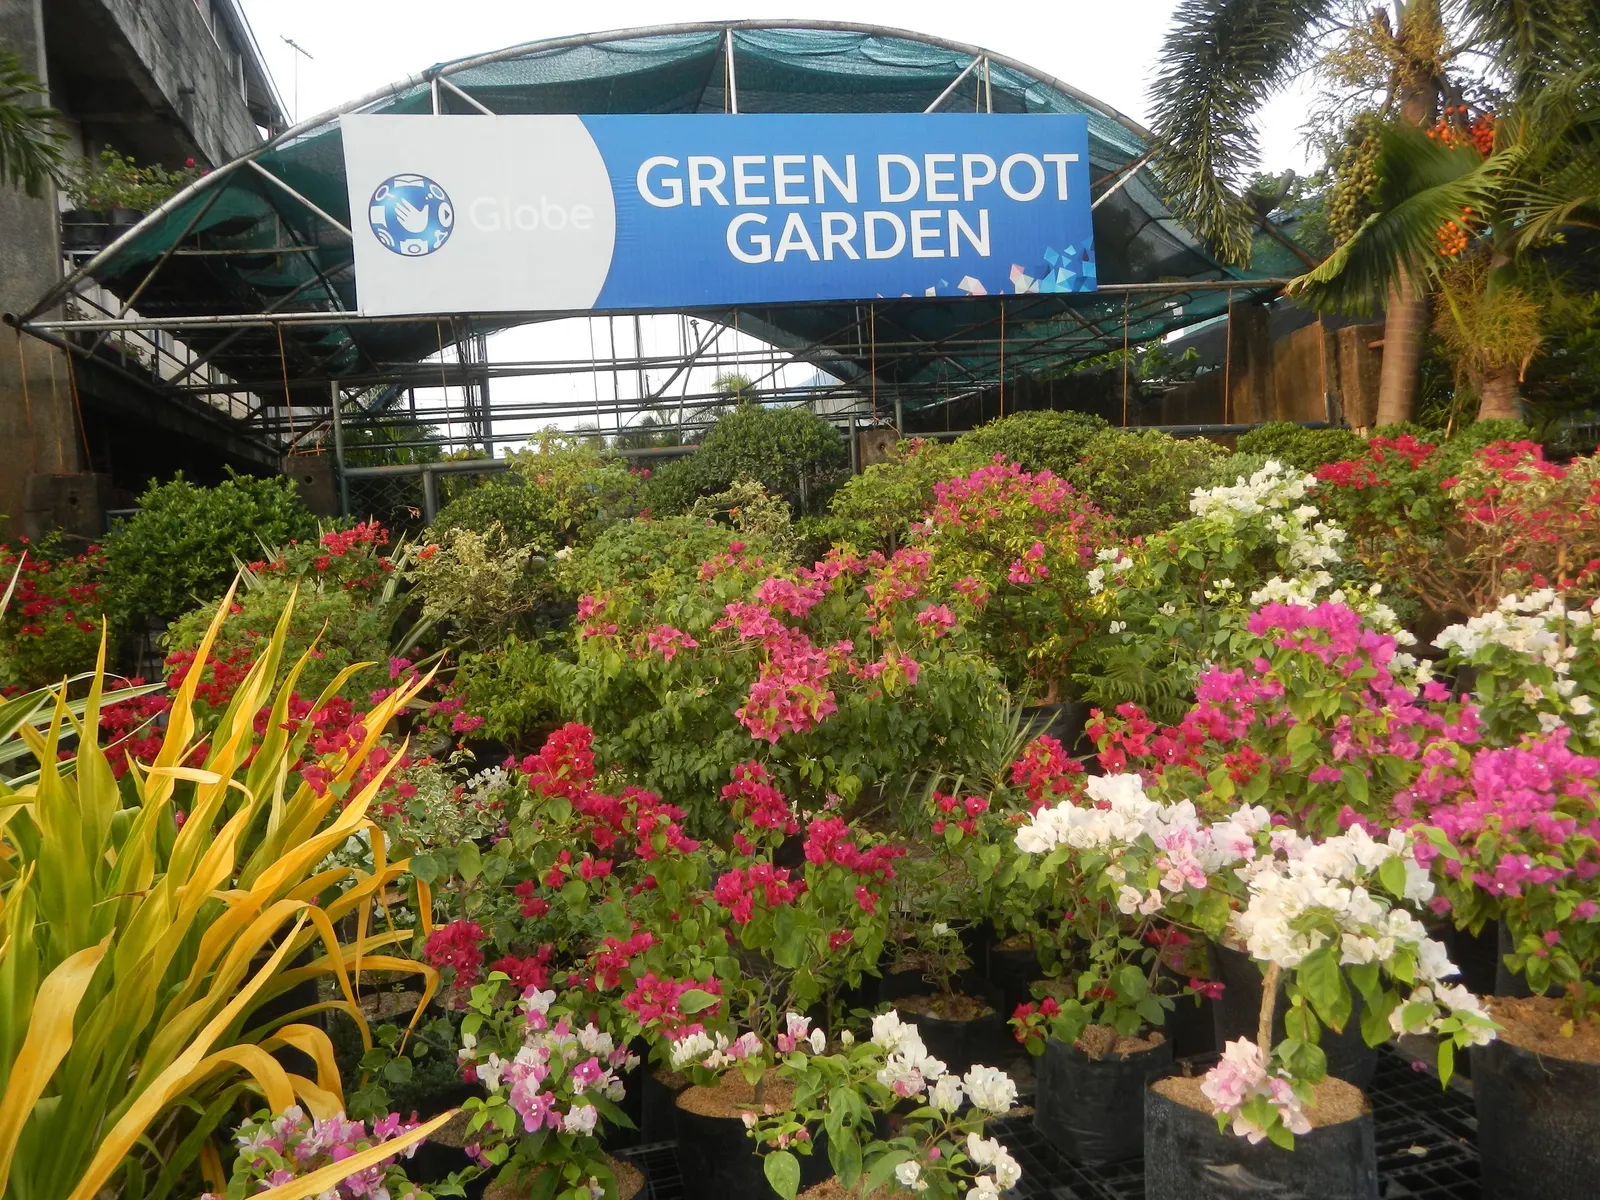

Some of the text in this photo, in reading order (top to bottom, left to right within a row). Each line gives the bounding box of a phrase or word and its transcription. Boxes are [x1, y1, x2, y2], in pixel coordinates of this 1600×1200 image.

[636, 152, 1080, 208] GREEN DEPOT
[468, 195, 595, 234] Globe
[725, 208, 991, 264] GARDEN
